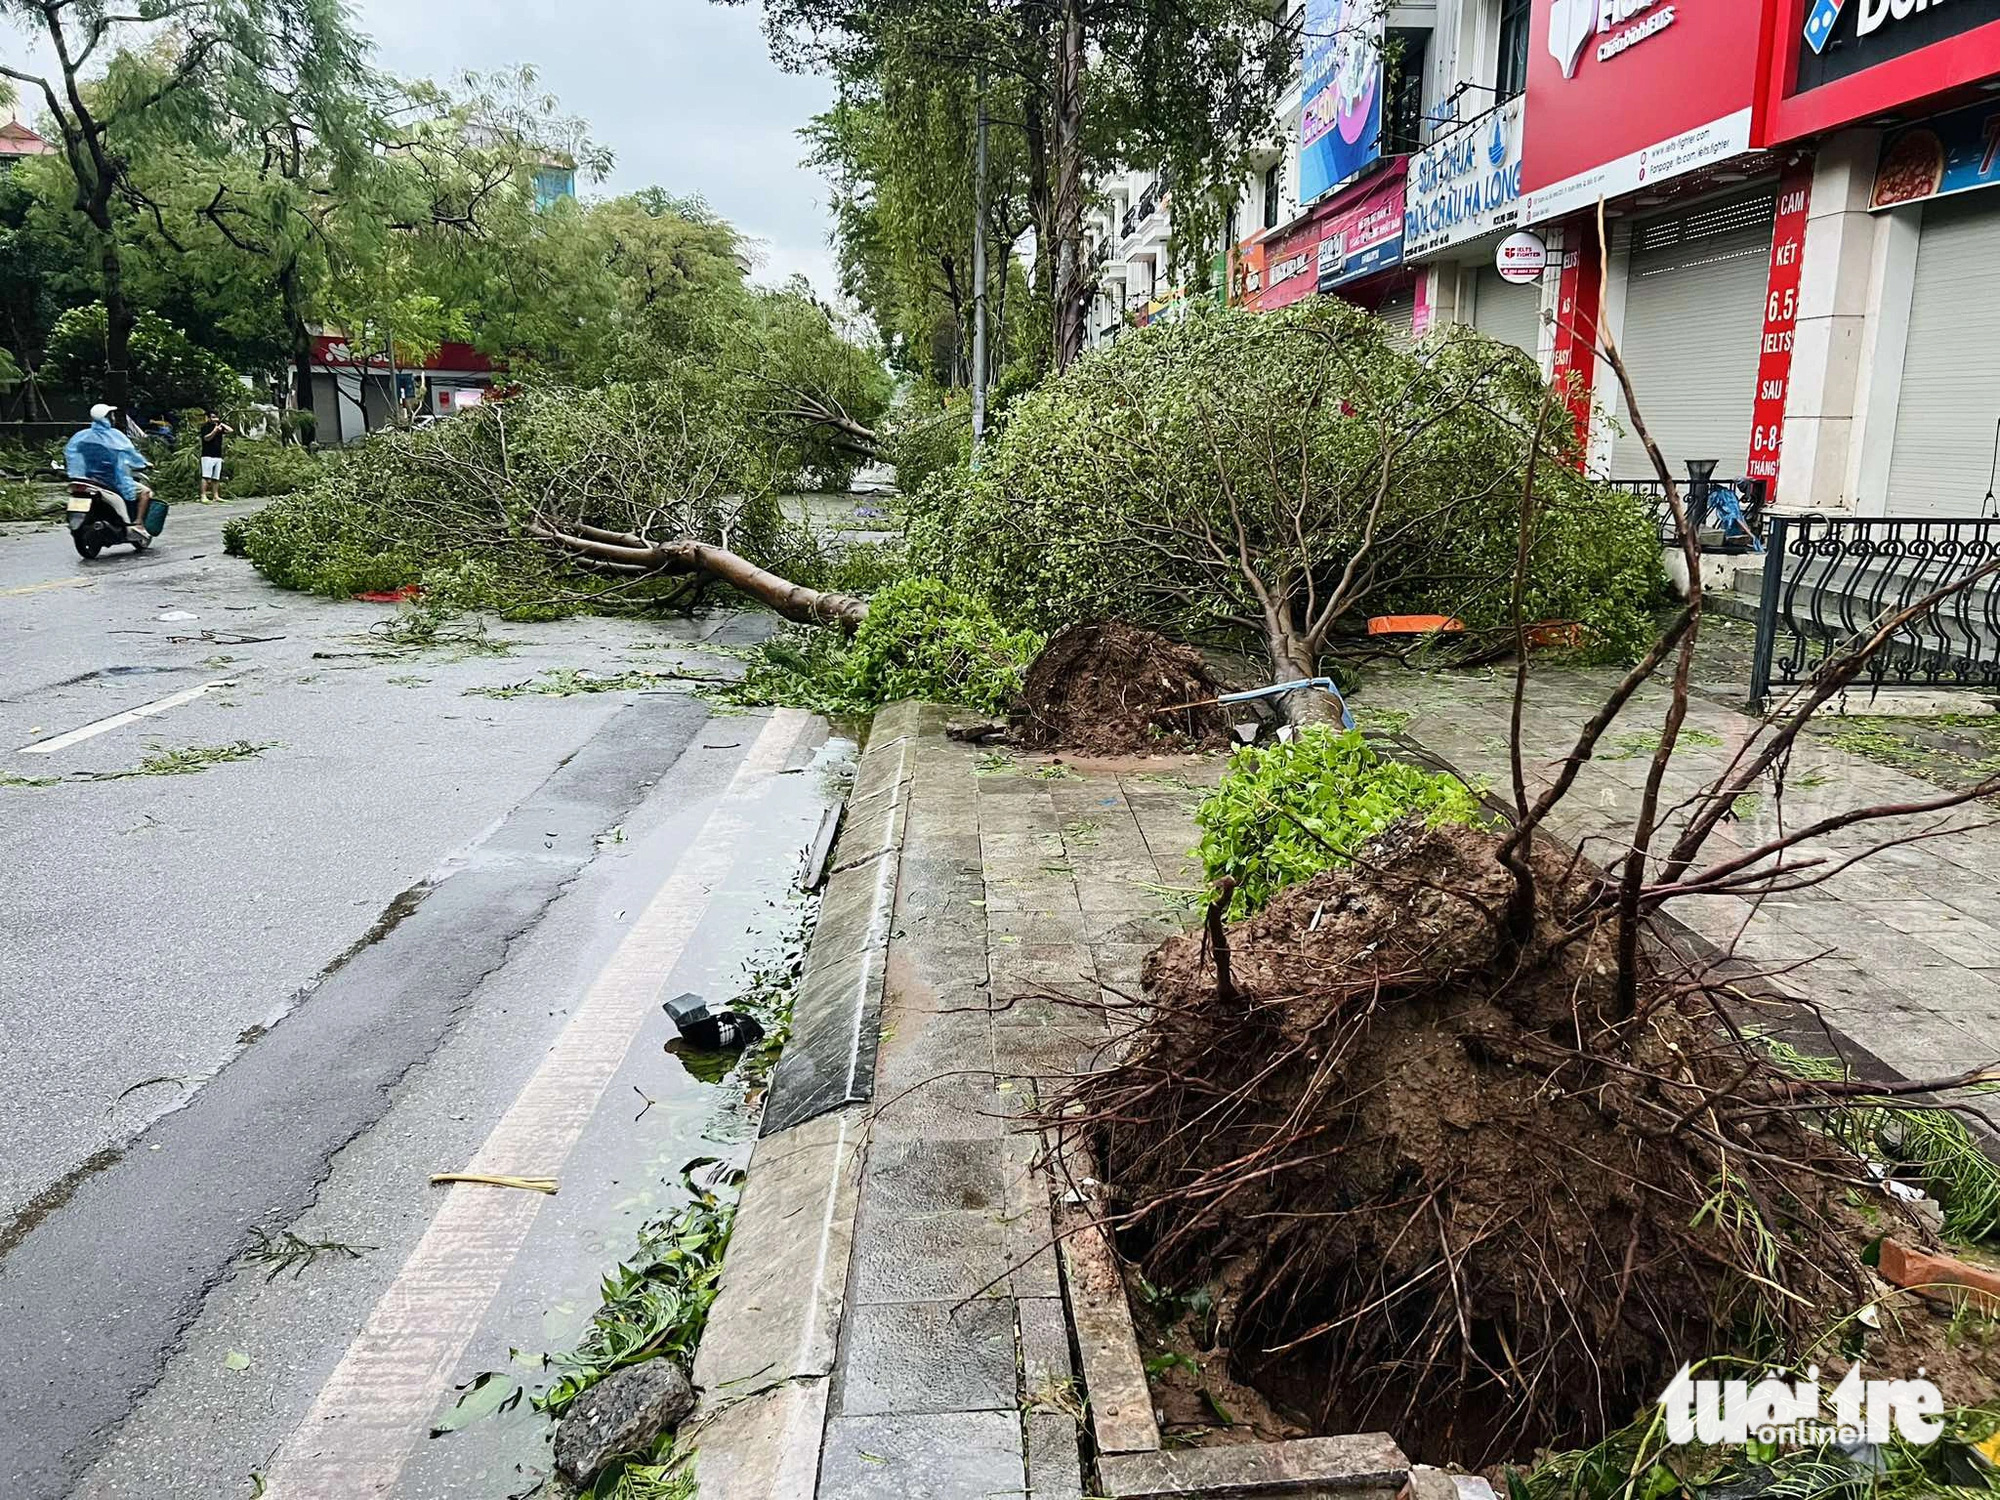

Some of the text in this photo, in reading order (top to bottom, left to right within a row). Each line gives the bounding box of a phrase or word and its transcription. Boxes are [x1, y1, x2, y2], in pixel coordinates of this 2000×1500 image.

[1485, 160, 1521, 209] LONG
[1781, 191, 1804, 216] CAM
[1776, 237, 1797, 266] KẾT
[1768, 289, 1794, 322] 6.5
[1763, 331, 1792, 353] IELTS
[1761, 380, 1783, 400] SAU
[1754, 425, 1777, 451] 6-8
[1750, 455, 1776, 476] THÁNG
